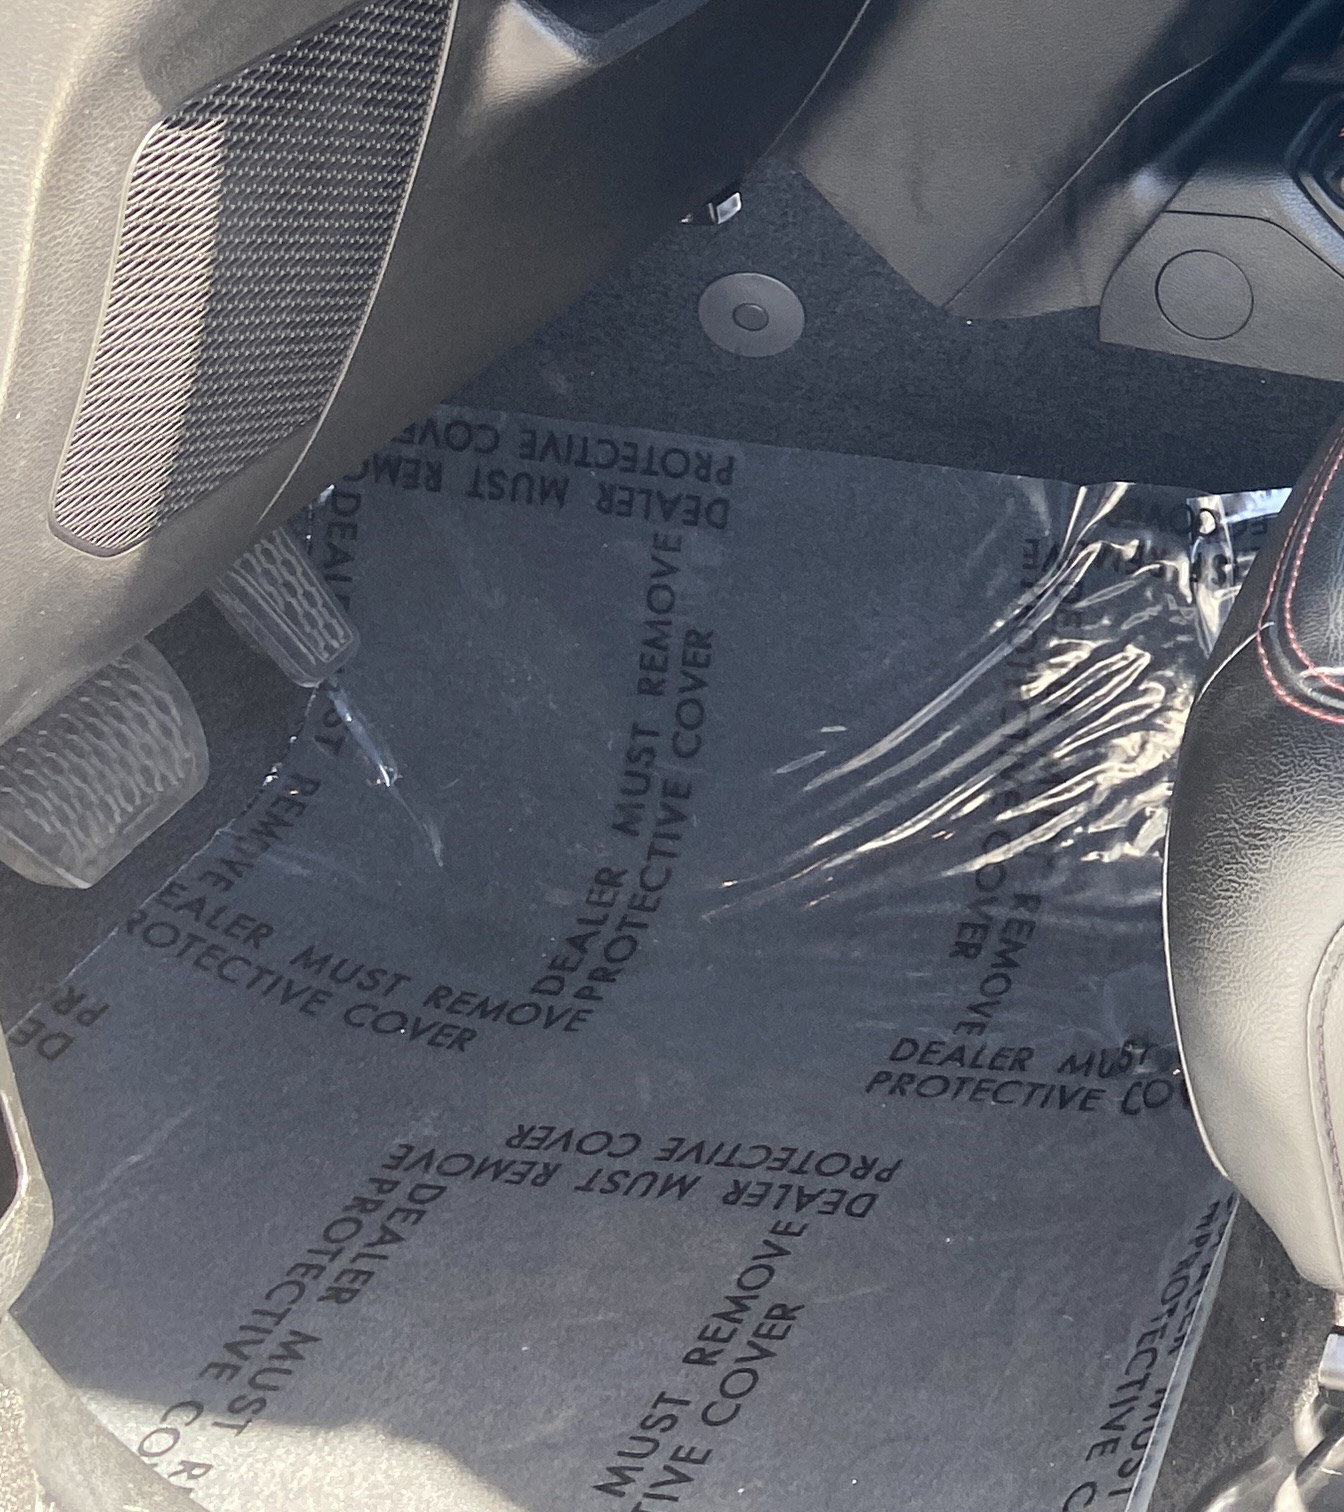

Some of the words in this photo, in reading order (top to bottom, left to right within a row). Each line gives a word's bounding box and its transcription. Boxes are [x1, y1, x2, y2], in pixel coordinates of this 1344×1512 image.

[394, 417, 500, 454] COVE
[519, 428, 735, 486] PROTECTIVE
[467, 465, 569, 509] MUST
[596, 482, 731, 531] DEALER
[531, 866, 622, 996] DEALER
[611, 722, 661, 837] MUST
[637, 533, 683, 698] REMOVE
[581, 775, 693, 1003] PROTECTIVE
[670, 628, 716, 759] COVER
[126, 909, 333, 1018] ROTECTIVE
[343, 1001, 479, 1053] COVER
[152, 881, 274, 950] EALER
[290, 944, 411, 997] MUST
[423, 984, 593, 1033] REMOVE
[953, 892, 1042, 1037] REMOVE
[889, 1036, 1034, 1072] DEALER
[864, 1070, 1106, 1112] PROTECTIVE
[381, 1143, 563, 1188] REMOVE
[504, 1122, 641, 1159] COVER
[653, 1135, 905, 1183] PROTECTIVE
[574, 1165, 702, 1202] MUST
[722, 1177, 880, 1219] DEALER
[317, 1179, 449, 1307] DEALER
[198, 1175, 400, 1383] PROTECTIVE
[210, 1328, 323, 1437] MUST
[592, 1390, 693, 1498] MUST
[682, 1219, 810, 1366] REMOVE
[700, 1302, 806, 1427] COVER
